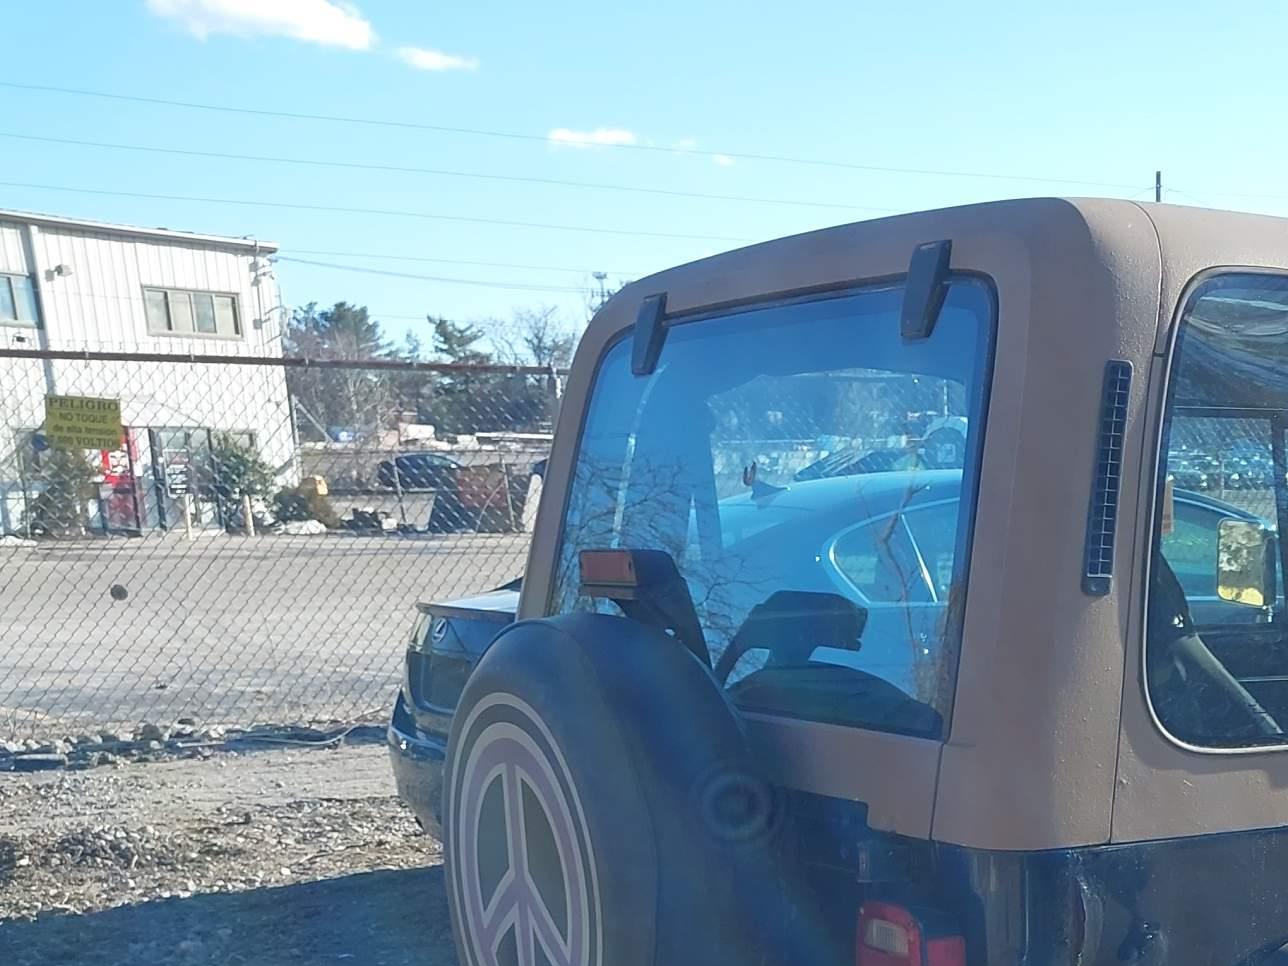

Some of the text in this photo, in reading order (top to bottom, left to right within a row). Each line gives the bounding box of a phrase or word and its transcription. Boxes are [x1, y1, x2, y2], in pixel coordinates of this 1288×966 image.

[48, 398, 119, 411] PELIGRO
[59, 412, 108, 424] NO TOQUE
